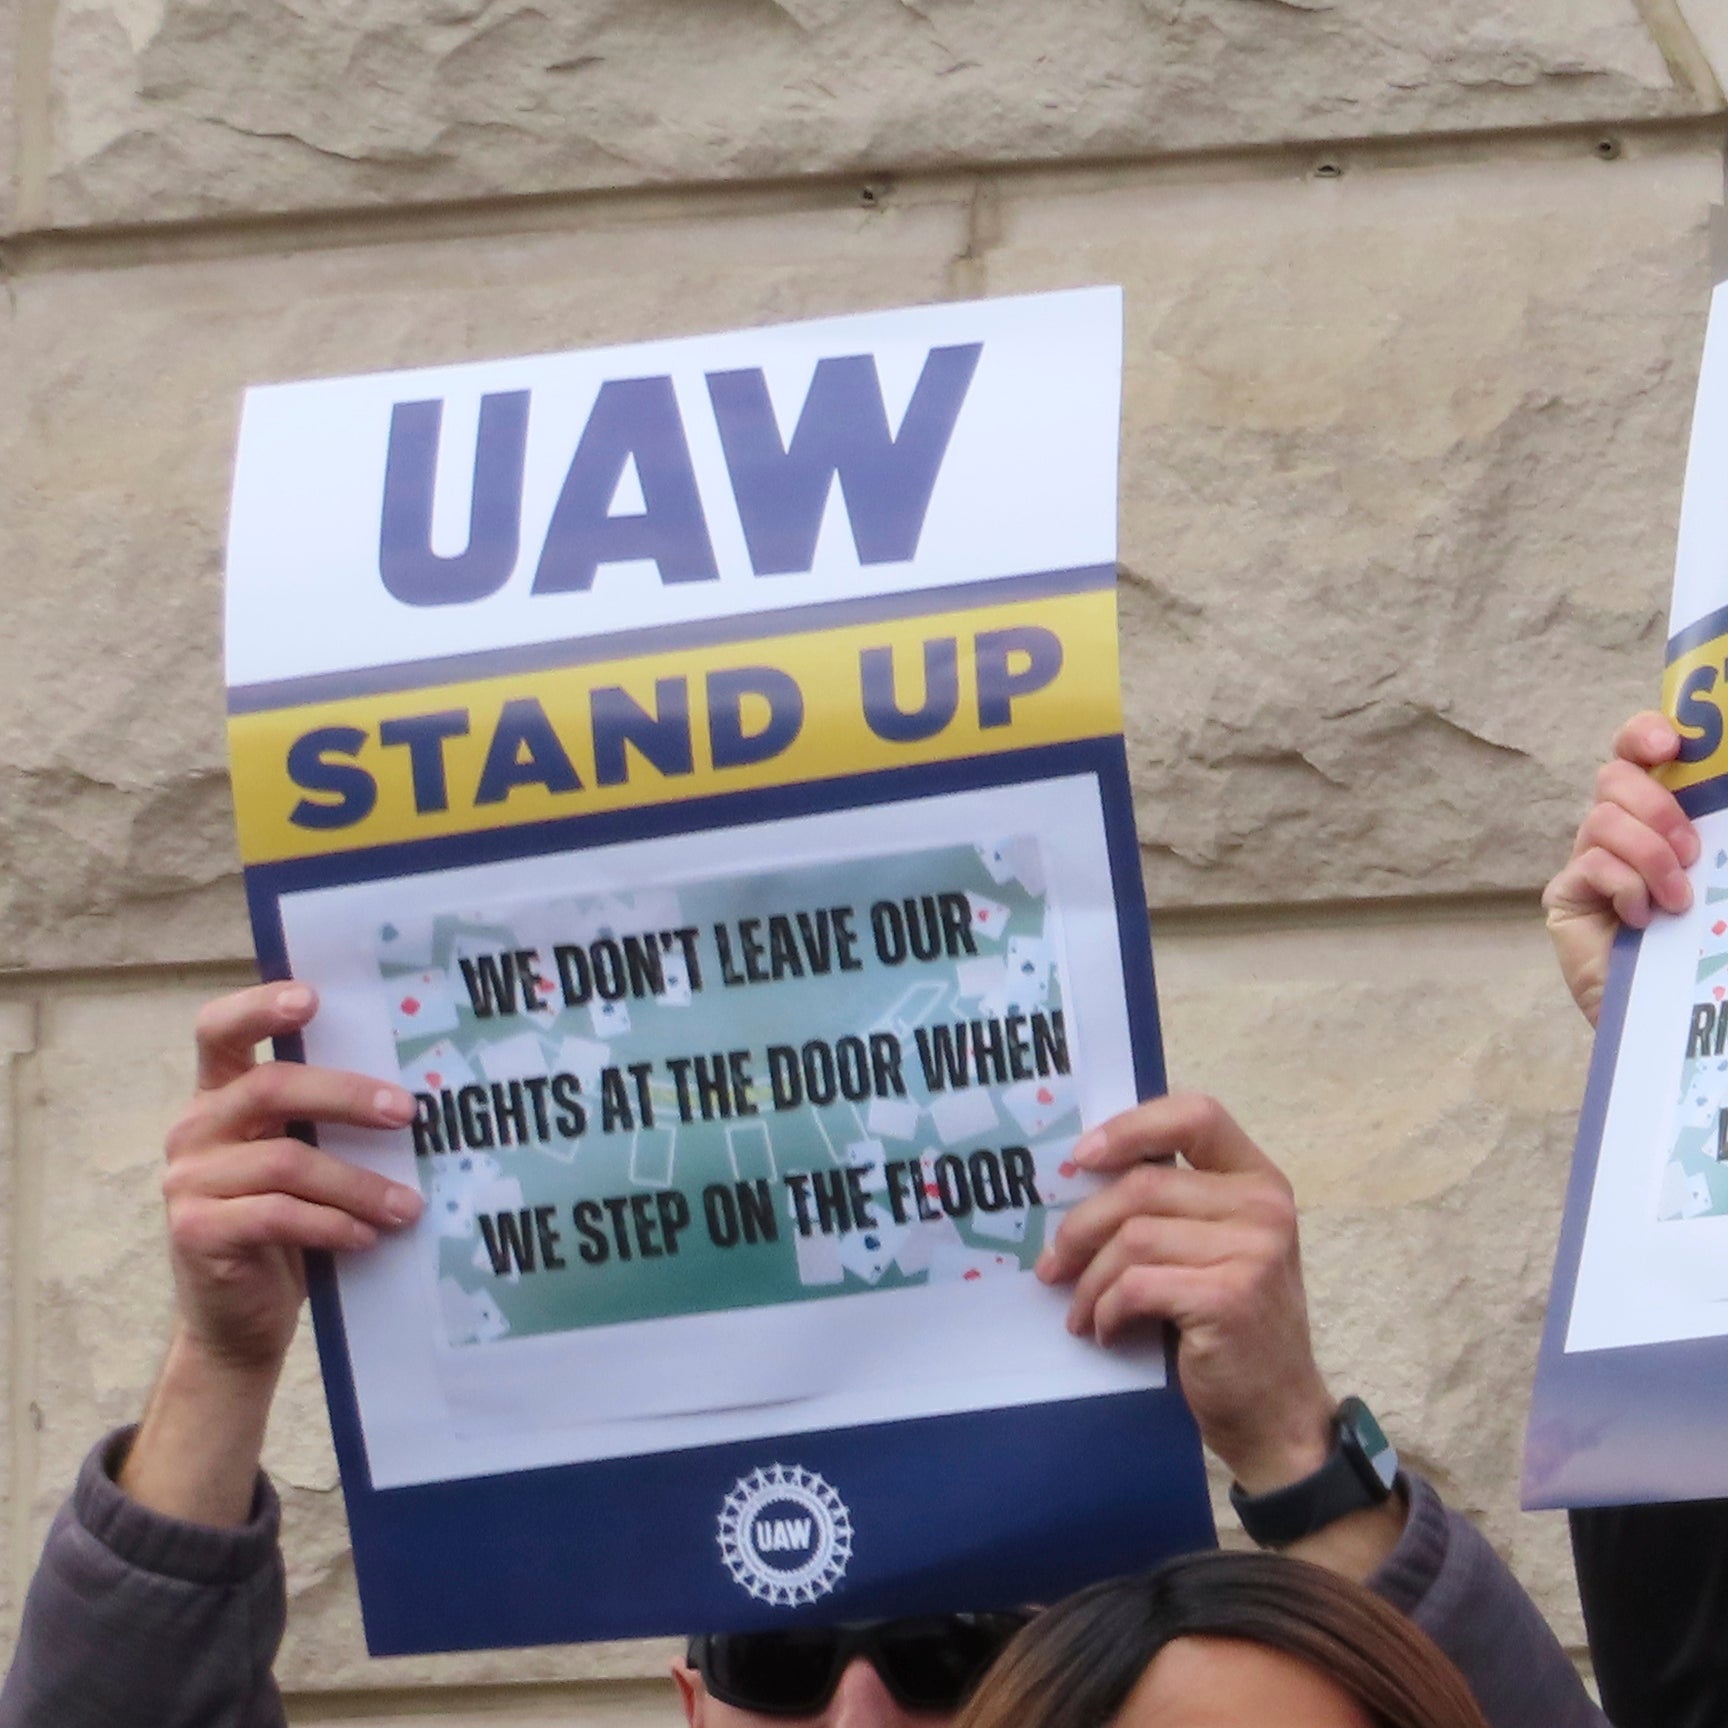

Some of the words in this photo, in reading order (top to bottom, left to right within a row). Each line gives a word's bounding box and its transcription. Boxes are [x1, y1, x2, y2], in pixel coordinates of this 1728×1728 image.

[379, 341, 984, 607] UAW
[286, 666, 805, 832] STAND
[858, 625, 1063, 744] UP
[459, 950, 551, 1018] WE
[555, 927, 702, 1005] DON'T
[715, 905, 862, 989] LEAVE
[871, 891, 977, 968] OUR
[412, 1080, 586, 1156] RIGHTS
[600, 1064, 656, 1134] AT
[666, 1046, 757, 1123] THE
[768, 1032, 905, 1107] DOOR
[914, 1009, 1073, 1092] WHEN
[479, 1208, 565, 1277] WE
[578, 1187, 691, 1263] STEP
[704, 1176, 779, 1252] ON
[785, 1163, 879, 1234] THE
[887, 1146, 1043, 1221] FLOOR
[756, 1517, 812, 1552] UAW
